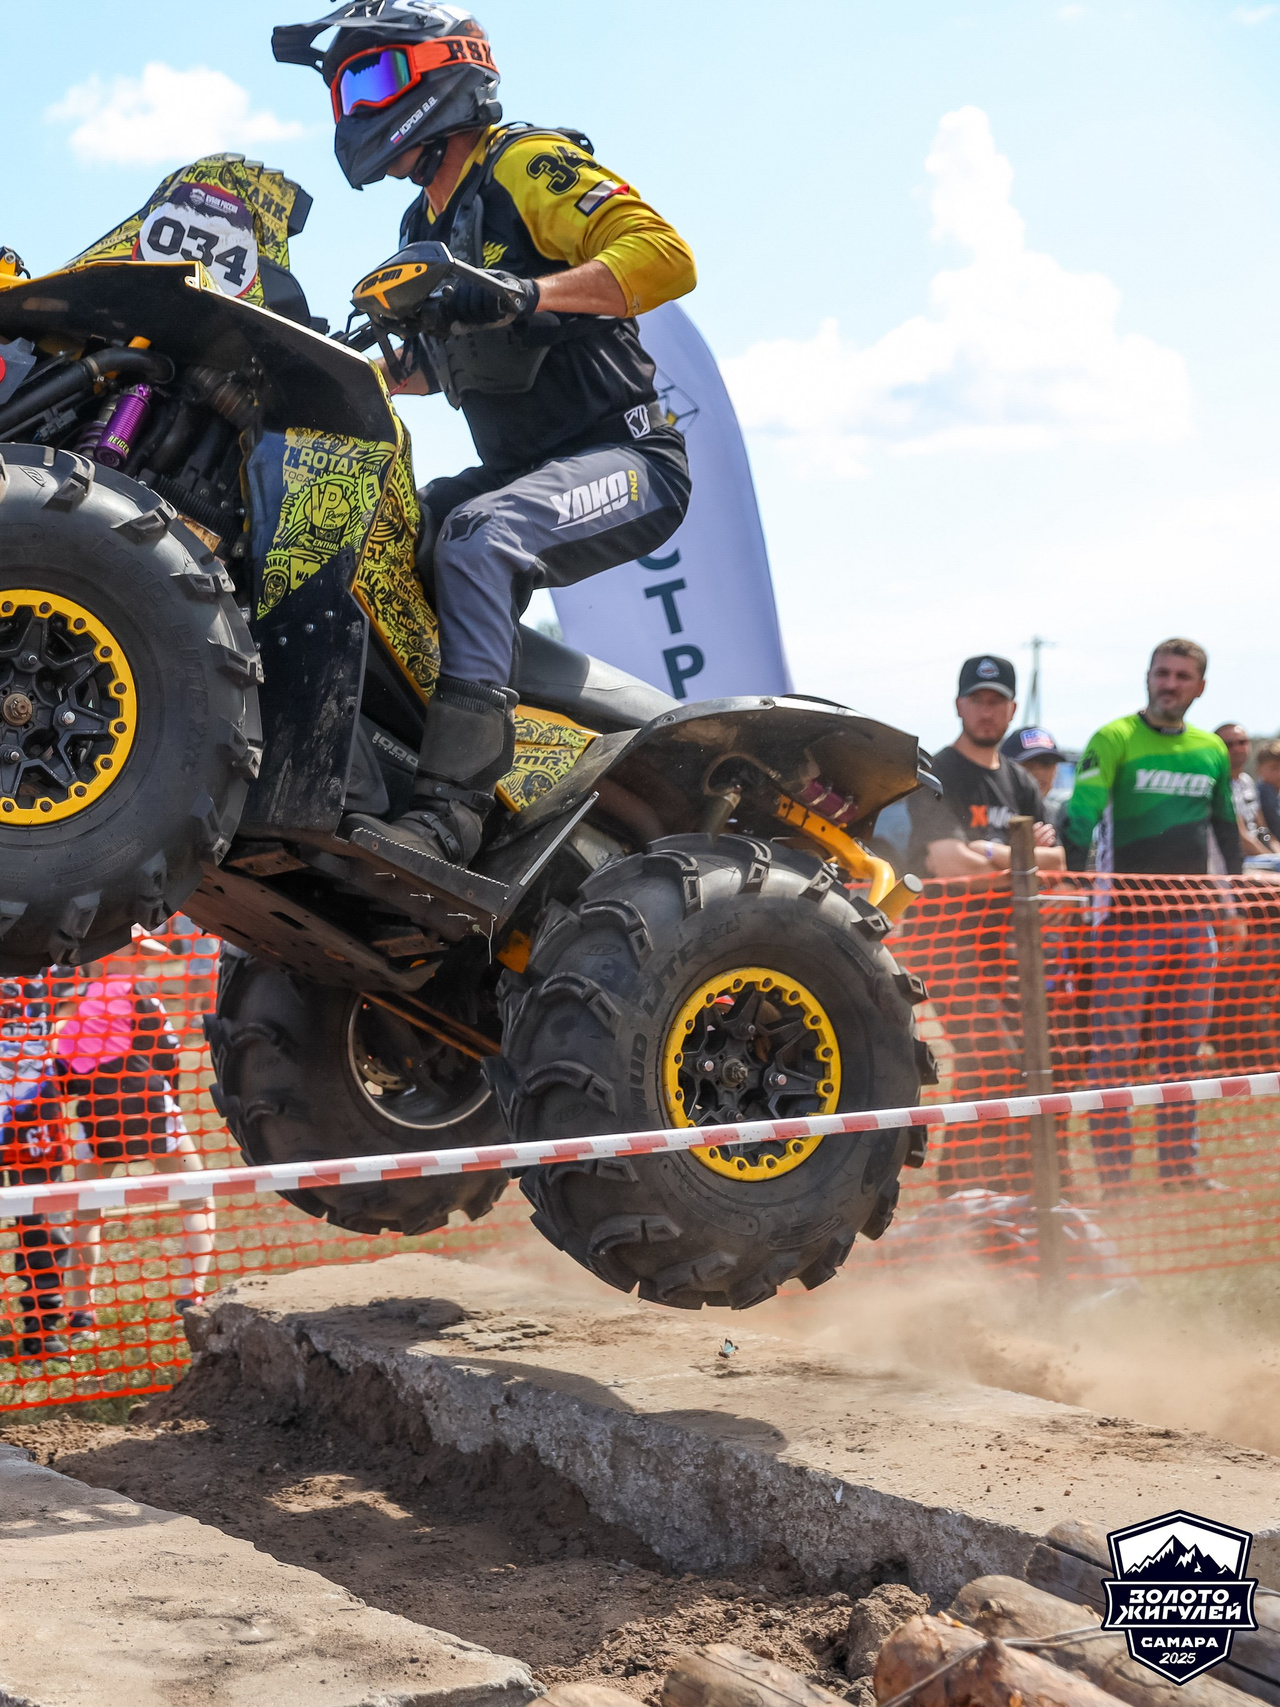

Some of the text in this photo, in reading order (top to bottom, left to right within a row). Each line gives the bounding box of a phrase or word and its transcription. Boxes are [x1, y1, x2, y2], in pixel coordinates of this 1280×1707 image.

[147, 216, 248, 287] 034
[299, 446, 363, 477] ROTAX
[310, 482, 345, 528] VP
[549, 470, 629, 529] YOKO
[312, 540, 340, 550] ENTHAL
[398, 614, 420, 633] NGK
[372, 732, 418, 767] 1000
[1133, 769, 1209, 797] YOKO
[629, 1032, 649, 1124] MUD
